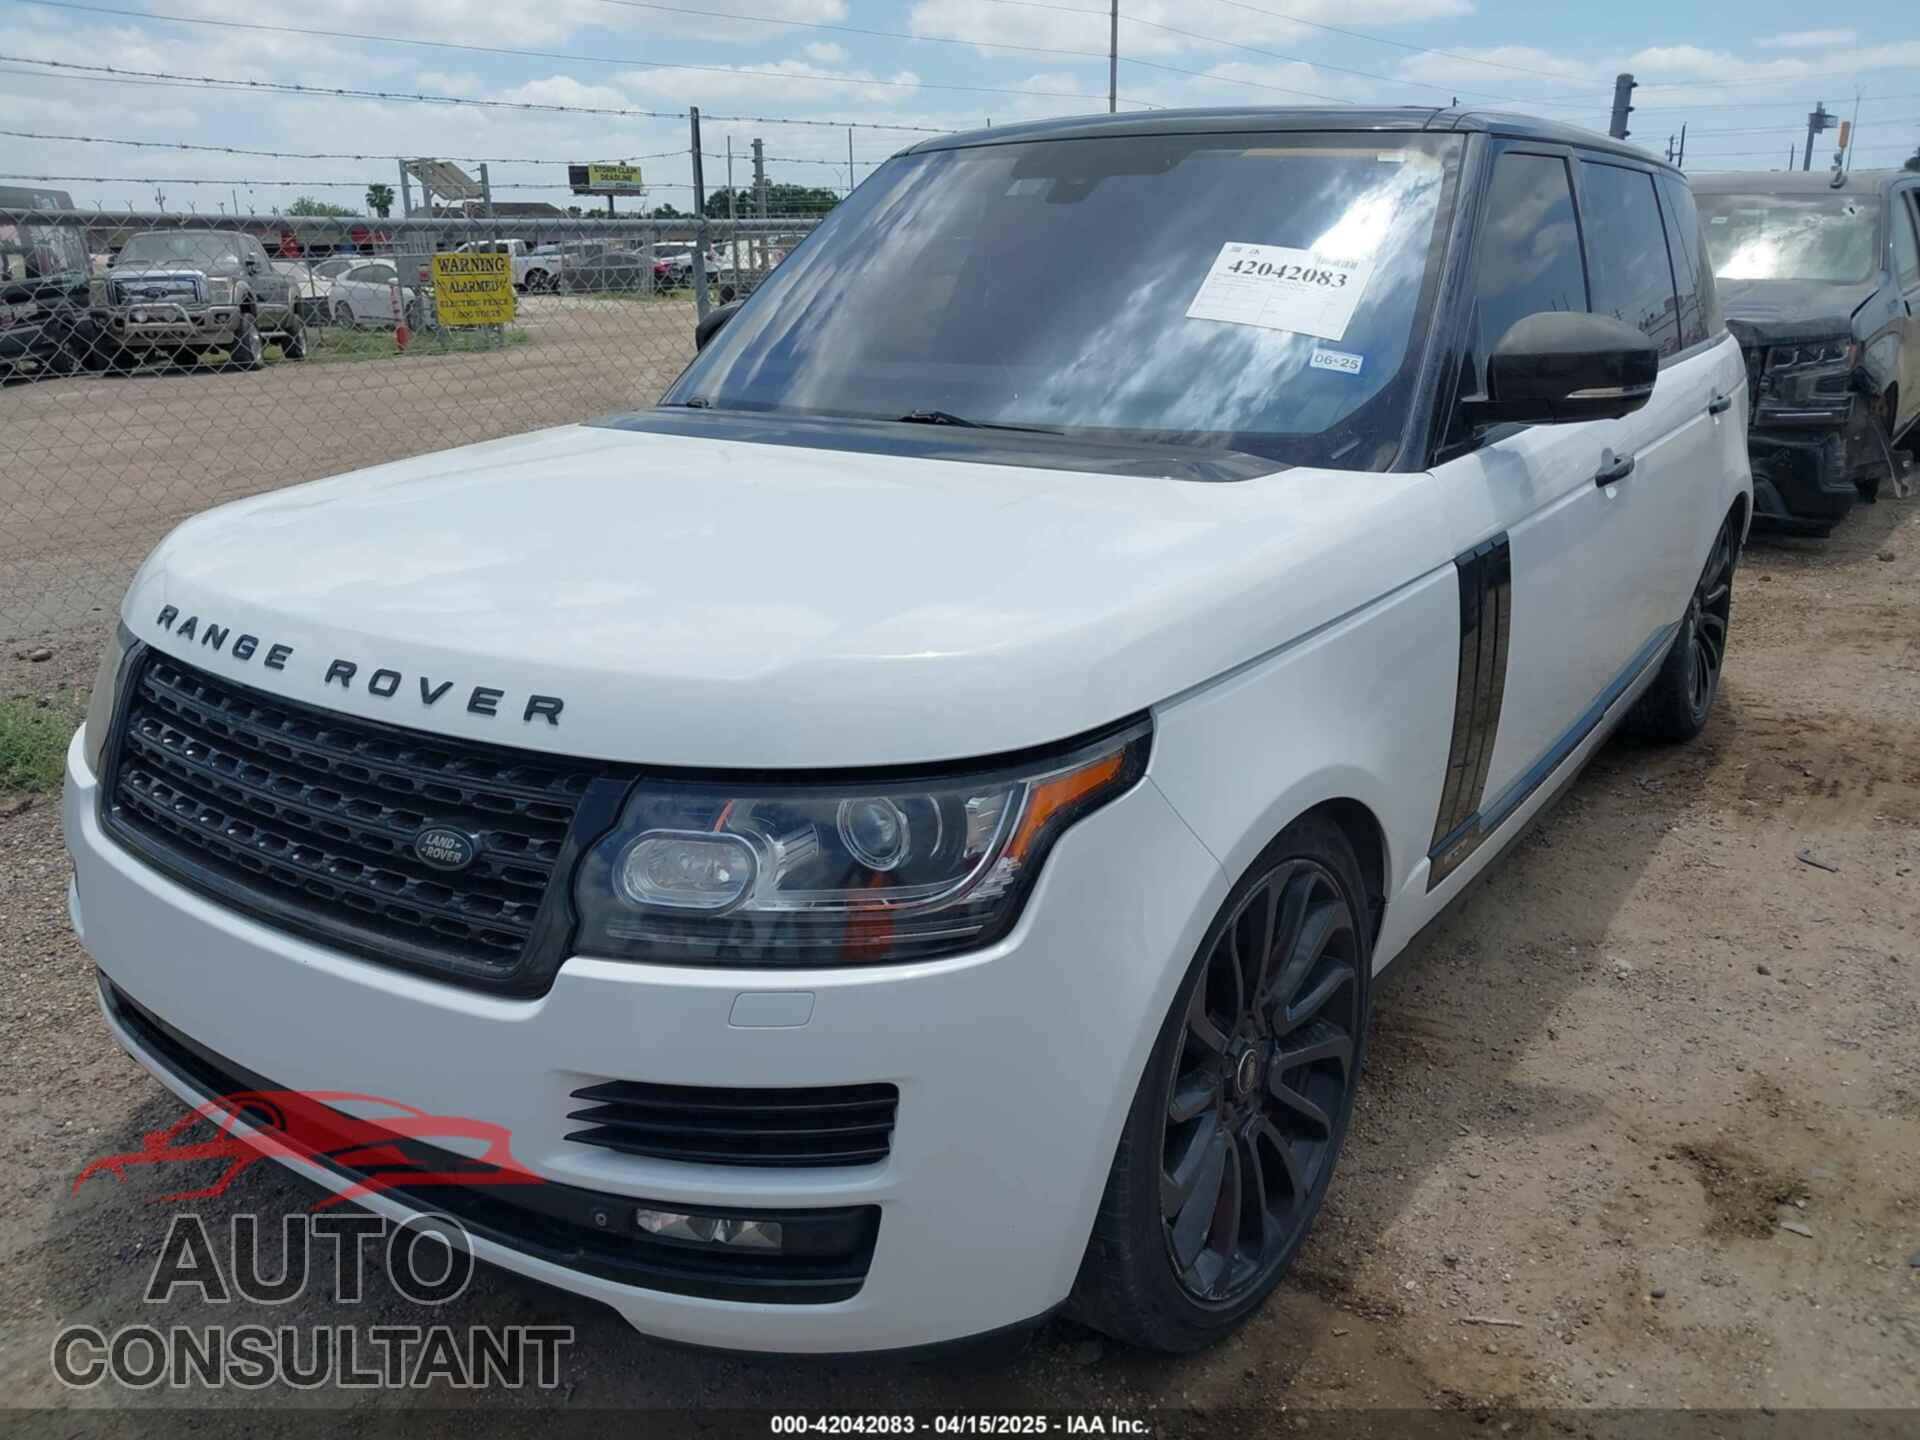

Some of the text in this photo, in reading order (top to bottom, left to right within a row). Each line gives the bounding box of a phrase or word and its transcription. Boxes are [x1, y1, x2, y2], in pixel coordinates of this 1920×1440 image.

[438, 257, 505, 273] WARNING
[1227, 259, 1349, 289] 42042083
[156, 602, 565, 726] RANGE ROVER
